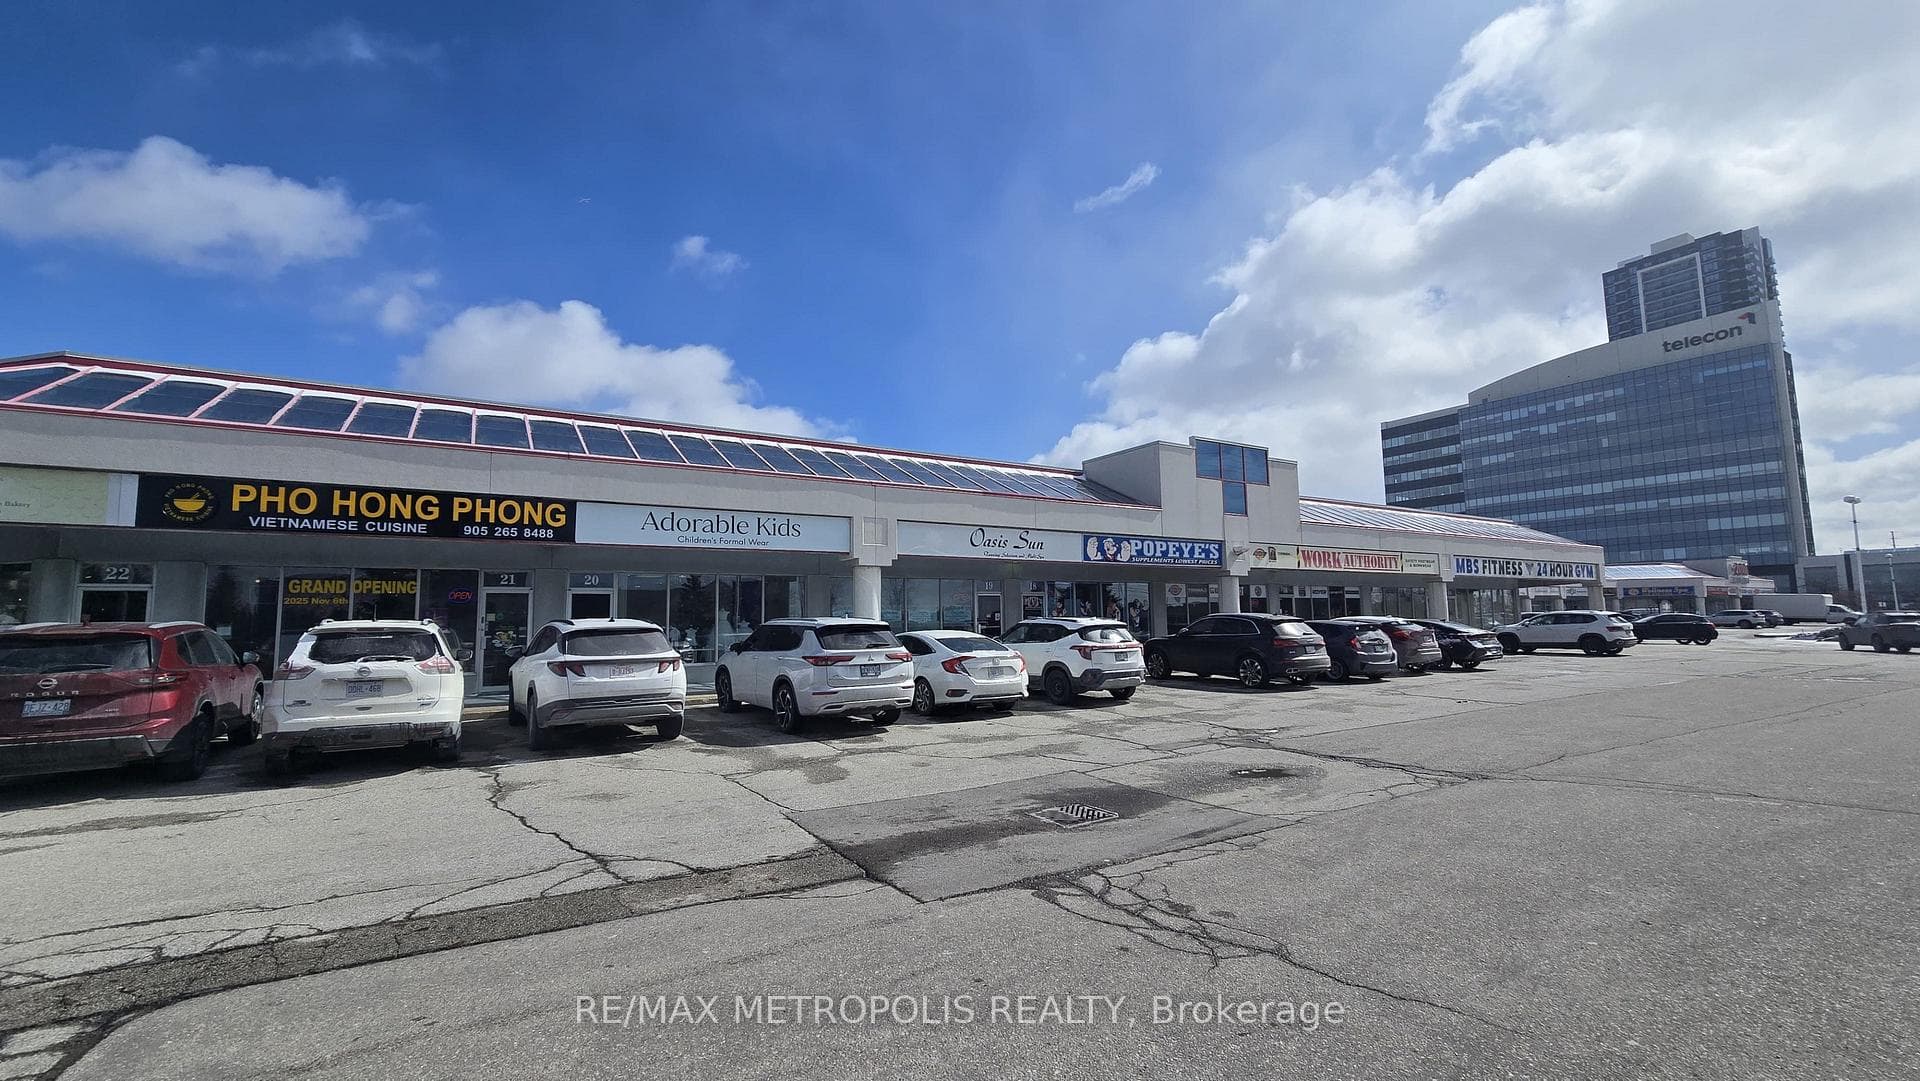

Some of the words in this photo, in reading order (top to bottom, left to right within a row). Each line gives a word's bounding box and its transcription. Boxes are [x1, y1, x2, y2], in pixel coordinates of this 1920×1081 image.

[1662, 325, 1743, 353] telecon
[231, 484, 318, 514] PHO
[332, 489, 440, 521] HONG
[452, 496, 567, 527] PHONG
[248, 516, 358, 531] VIETNAMESE
[365, 521, 428, 534] CUISINE
[640, 511, 749, 535] Adorable
[757, 517, 801, 538] Kids
[463, 525, 488, 536] 905
[494, 526, 518, 537] 265
[523, 527, 554, 539] 8488
[969, 527, 1009, 549] Oasis
[1013, 530, 1044, 550] Sun
[677, 535, 717, 544] Children's
[719, 537, 746, 546] Formal
[749, 538, 770, 547] Wear
[1129, 539, 1219, 559] POPEYE'S
[1300, 550, 1343, 569] WORK
[1344, 554, 1400, 570] AUTHORITY
[105, 567, 130, 580] 22
[1455, 558, 1480, 574] MBS
[1482, 560, 1523, 576] FITNESS
[1536, 563, 1548, 577] 24
[1550, 563, 1574, 578] HOUR
[1575, 564, 1594, 578] GYM
[500, 574, 516, 585] 21
[584, 575, 599, 586] 20
[985, 581, 993, 590] 19
[1029, 582, 1037, 590] 18
[288, 580, 347, 594] GRAND
[352, 580, 417, 594] OPENING
[284, 597, 311, 605] 2025
[311, 597, 329, 605] Nov
[332, 597, 349, 605] 6th
[448, 591, 473, 600] OPEN
